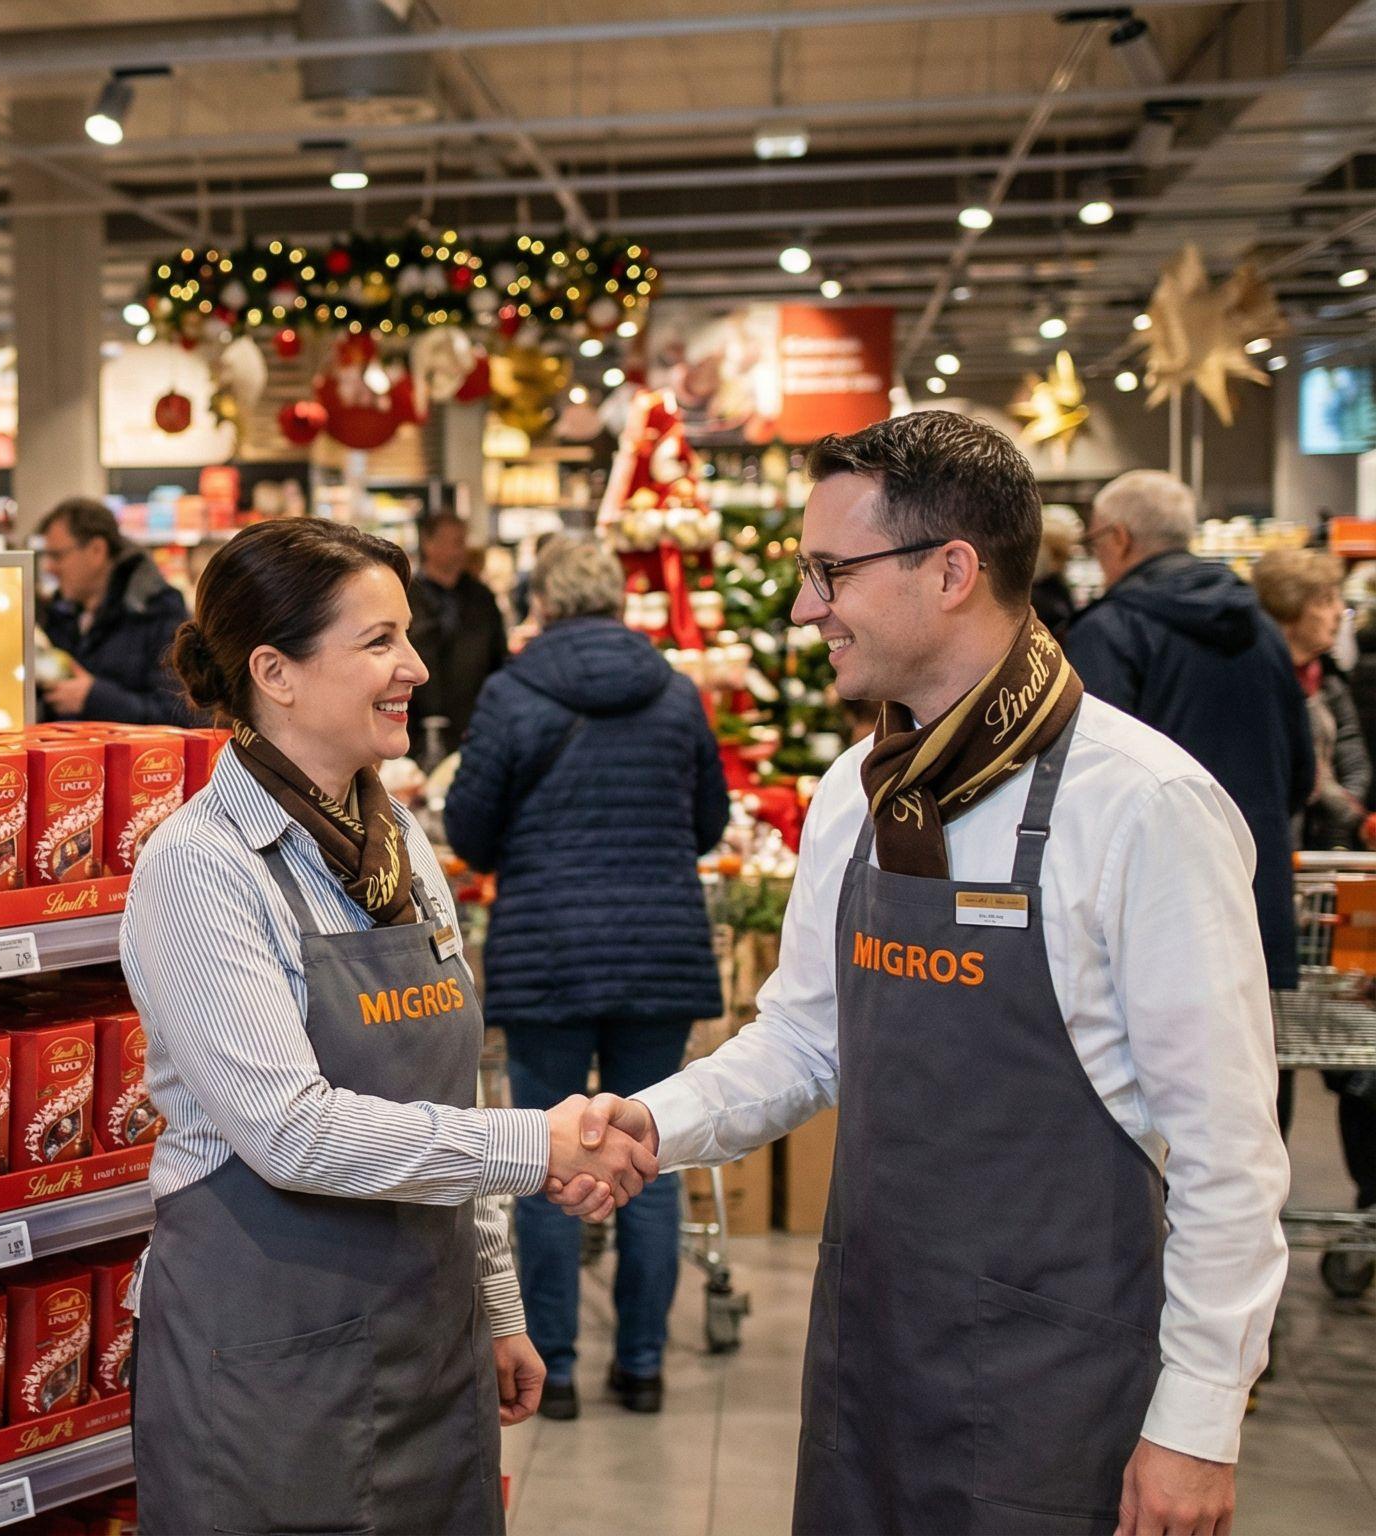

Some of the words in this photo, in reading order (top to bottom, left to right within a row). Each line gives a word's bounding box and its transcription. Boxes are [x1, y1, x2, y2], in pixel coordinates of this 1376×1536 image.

[985, 646, 1050, 745] Lindt
[853, 932, 985, 986] MIGROS
[358, 977, 464, 1025] MIGROS
